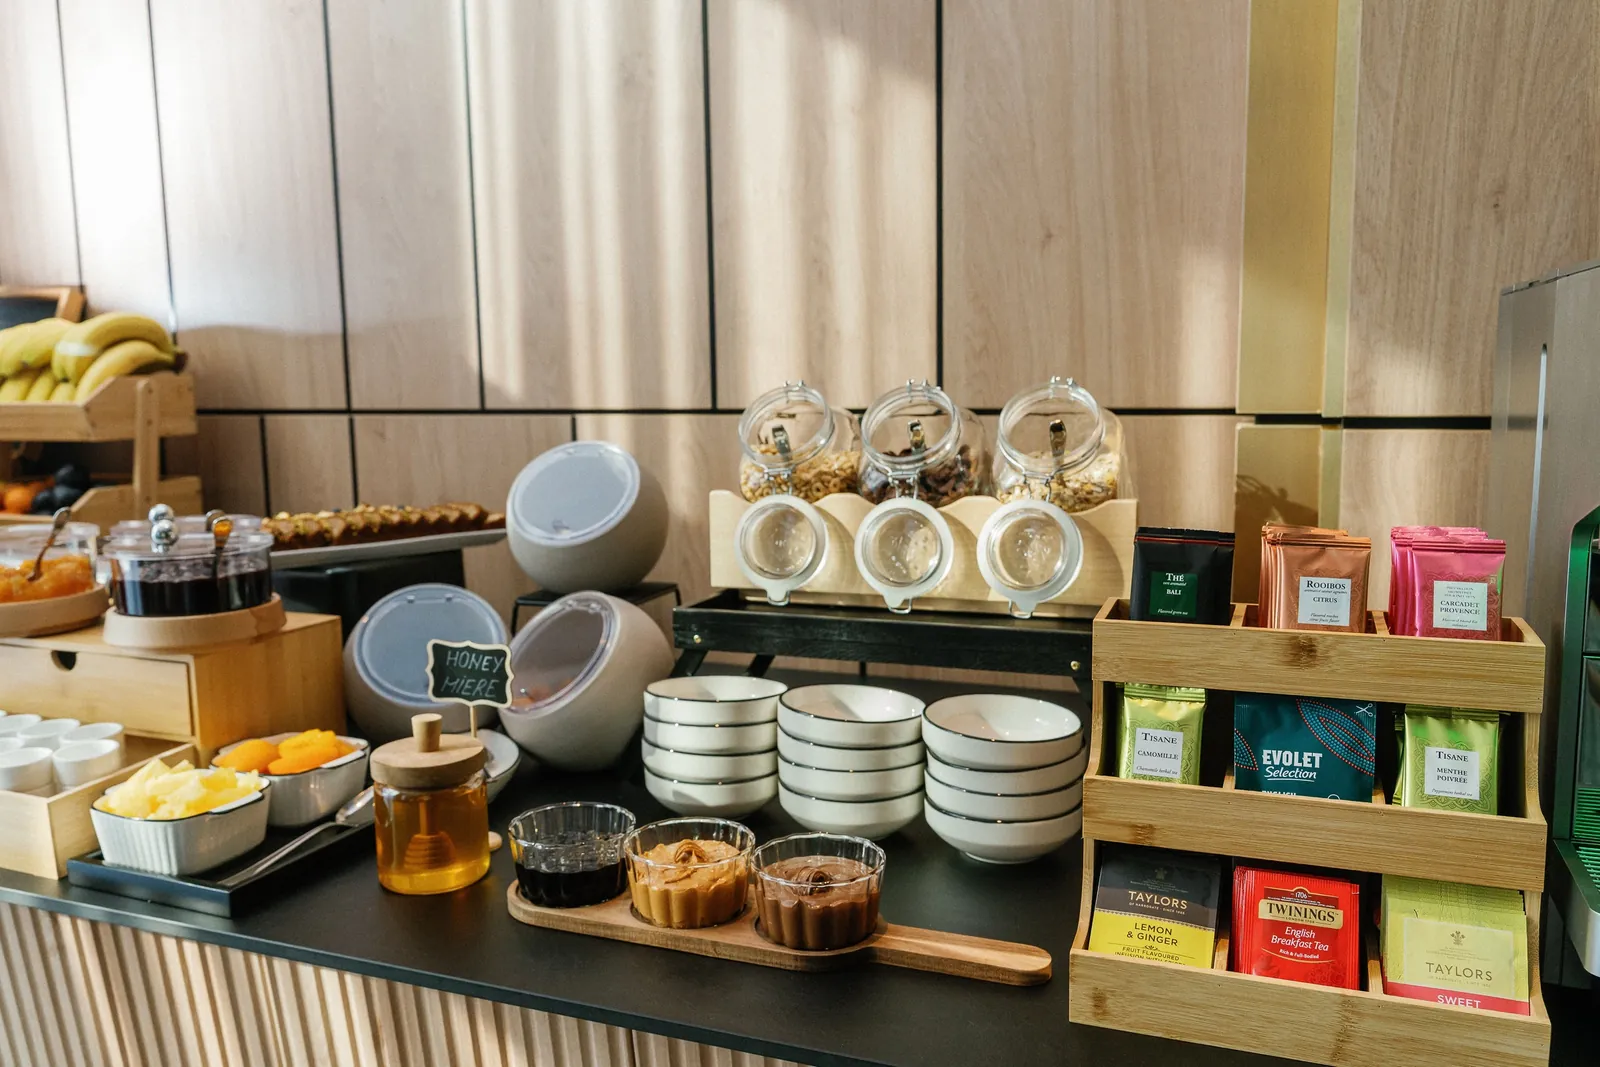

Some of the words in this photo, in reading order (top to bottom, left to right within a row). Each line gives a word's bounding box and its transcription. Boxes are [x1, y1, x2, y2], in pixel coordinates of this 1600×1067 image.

[1166, 572, 1185, 582] THÉ
[1307, 580, 1346, 590] ROOIBOS
[1440, 600, 1480, 608] CARCADET
[1440, 607, 1481, 615] PROVENCE
[446, 650, 504, 674] HONEY
[1141, 732, 1178, 744] TISANE
[1137, 750, 1179, 760] CAMOMILLE
[1262, 749, 1323, 769] EVOLET
[1435, 751, 1469, 762] TISANE
[1264, 766, 1317, 779] Selection
[1437, 767, 1468, 776] MENTHE
[1437, 775, 1468, 784] POIVRÉE
[1128, 890, 1188, 910] TAYLORS
[1267, 902, 1335, 922] TWININGS
[1134, 922, 1173, 936] LEMON
[1285, 926, 1316, 939] English
[1126, 930, 1133, 939] &
[1137, 932, 1178, 946] GINGER
[1271, 934, 1312, 949] Breakfast
[1314, 940, 1329, 951] Tea
[1122, 946, 1141, 954] FRUIT
[1142, 950, 1180, 961] FLAVOURED
[1425, 962, 1492, 981] TAYLORS
[1437, 994, 1481, 1009] SWEET
